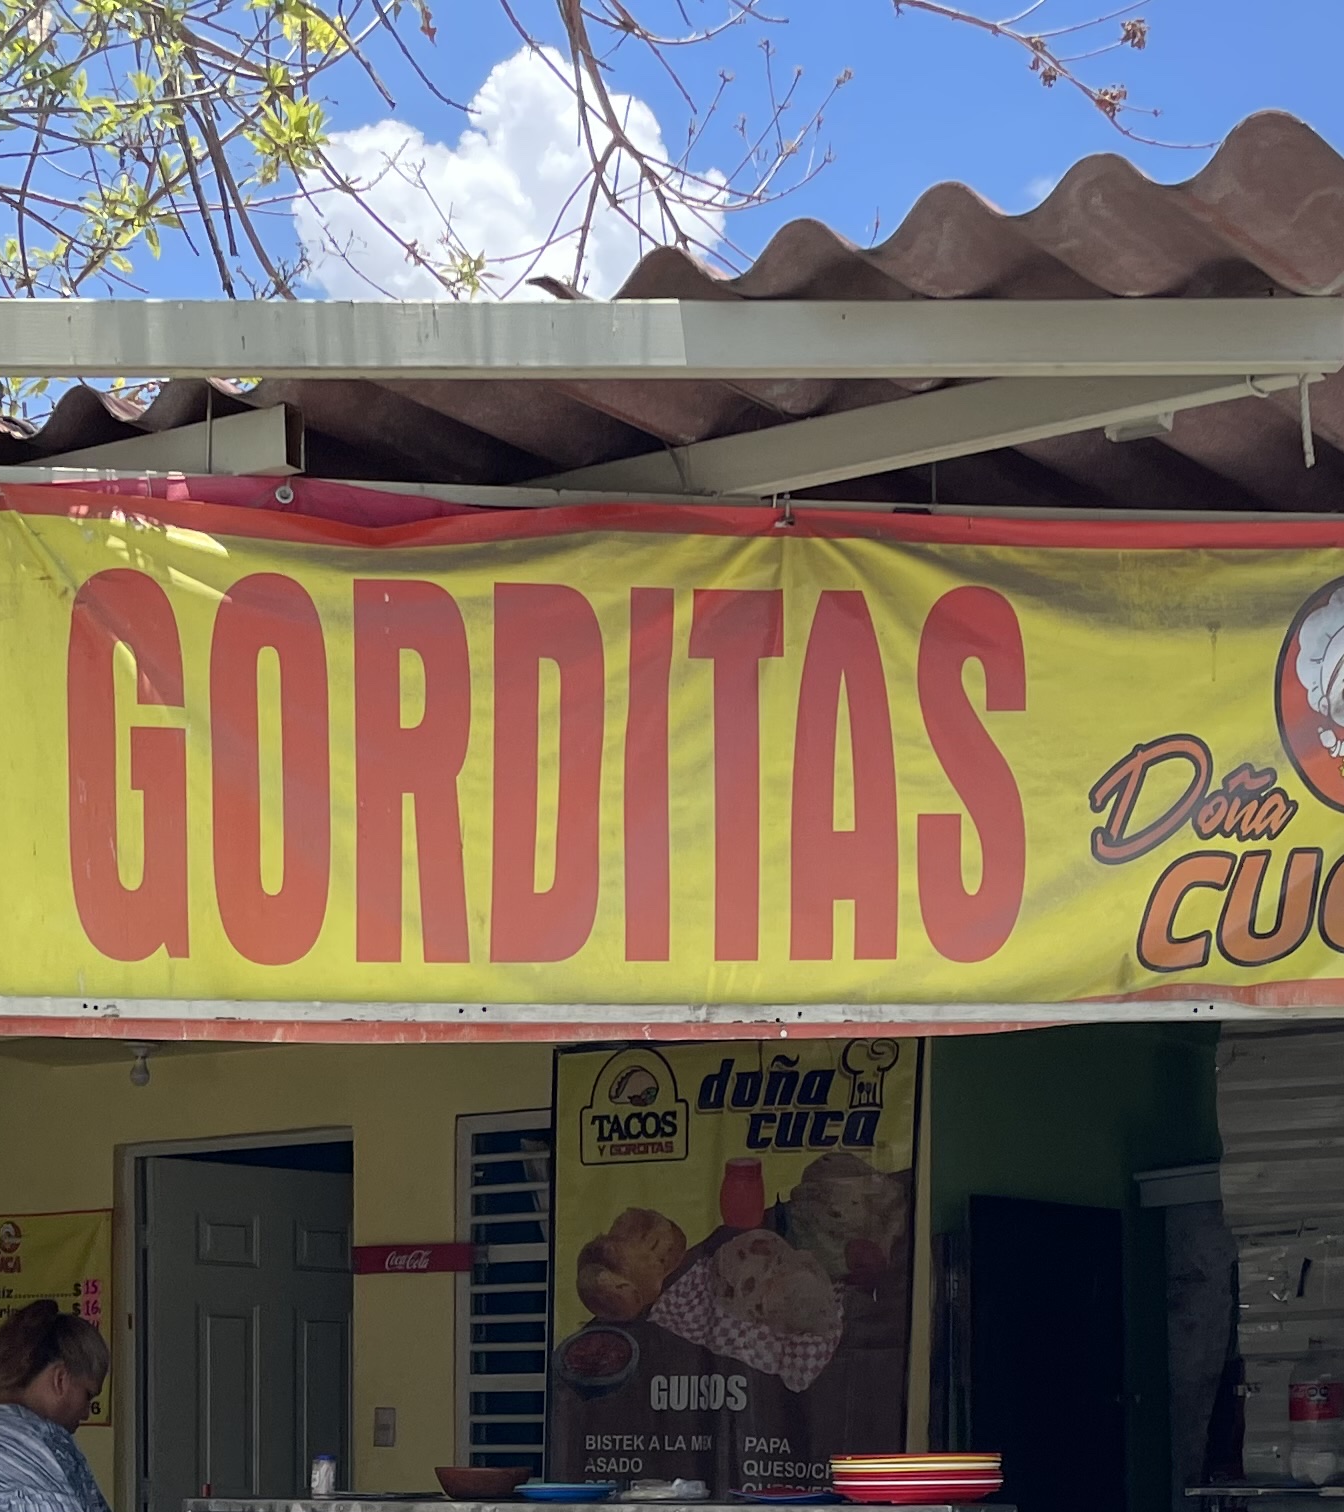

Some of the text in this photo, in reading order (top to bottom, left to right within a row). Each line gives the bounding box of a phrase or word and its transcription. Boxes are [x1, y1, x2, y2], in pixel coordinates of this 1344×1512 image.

[66, 566, 1028, 967] GORDITAS
[1089, 732, 1299, 865] Doña
[695, 1054, 836, 1112] doña
[591, 1110, 678, 1142] TACOS
[597, 1144, 606, 1157] Y
[385, 1249, 432, 1271] Coca-Cola
[650, 1373, 748, 1412] GUISOS
[585, 1434, 645, 1452] BISTEK
[648, 1434, 661, 1452] A
[664, 1434, 687, 1452] LA
[744, 1436, 792, 1455] PAPA
[584, 1457, 643, 1473] ASADO
